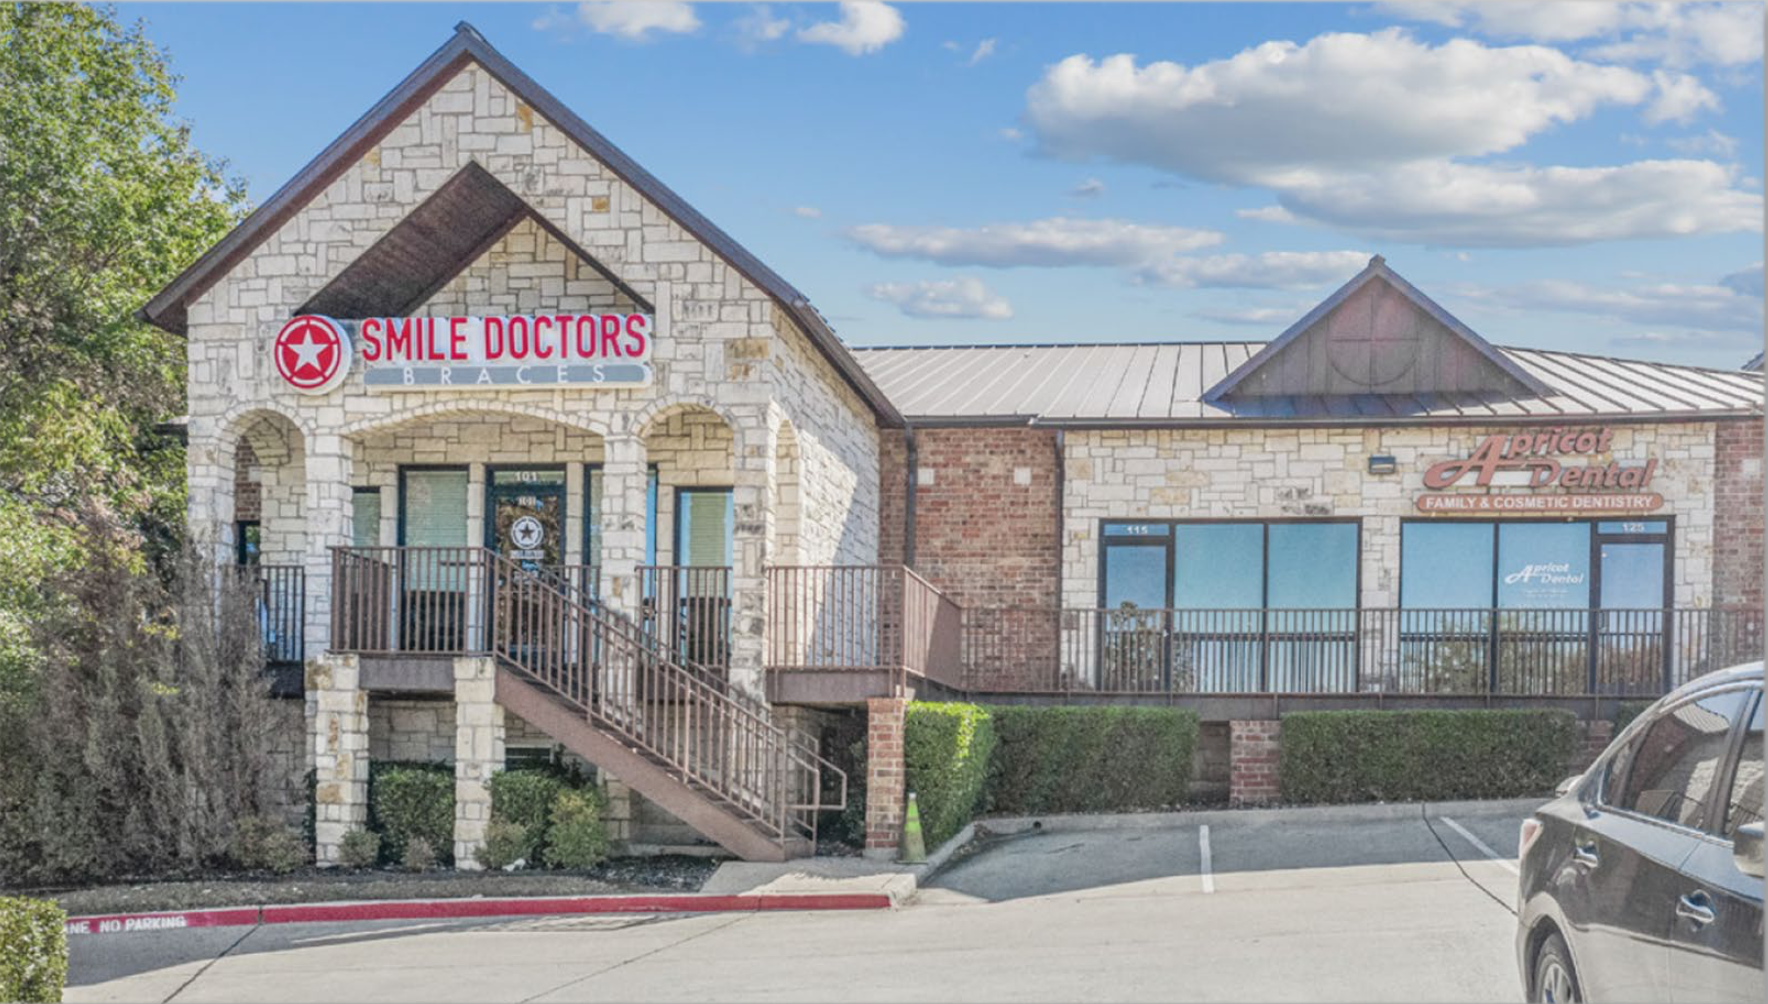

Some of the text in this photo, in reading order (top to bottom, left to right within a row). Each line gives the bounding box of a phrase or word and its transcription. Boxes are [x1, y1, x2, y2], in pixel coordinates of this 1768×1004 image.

[361, 313, 646, 362] SMILE DOCTORS
[403, 364, 606, 386] BRACES
[1422, 426, 1613, 489] Apricot
[514, 470, 538, 482] 101
[1528, 458, 1659, 488] Dental
[1425, 496, 1654, 509] FAMILY & COSMETIC DENTISTRY
[1622, 522, 1645, 533] 125
[1504, 562, 1570, 585] Apricot
[99, 918, 121, 933] NO
[125, 915, 188, 932] PARKING
